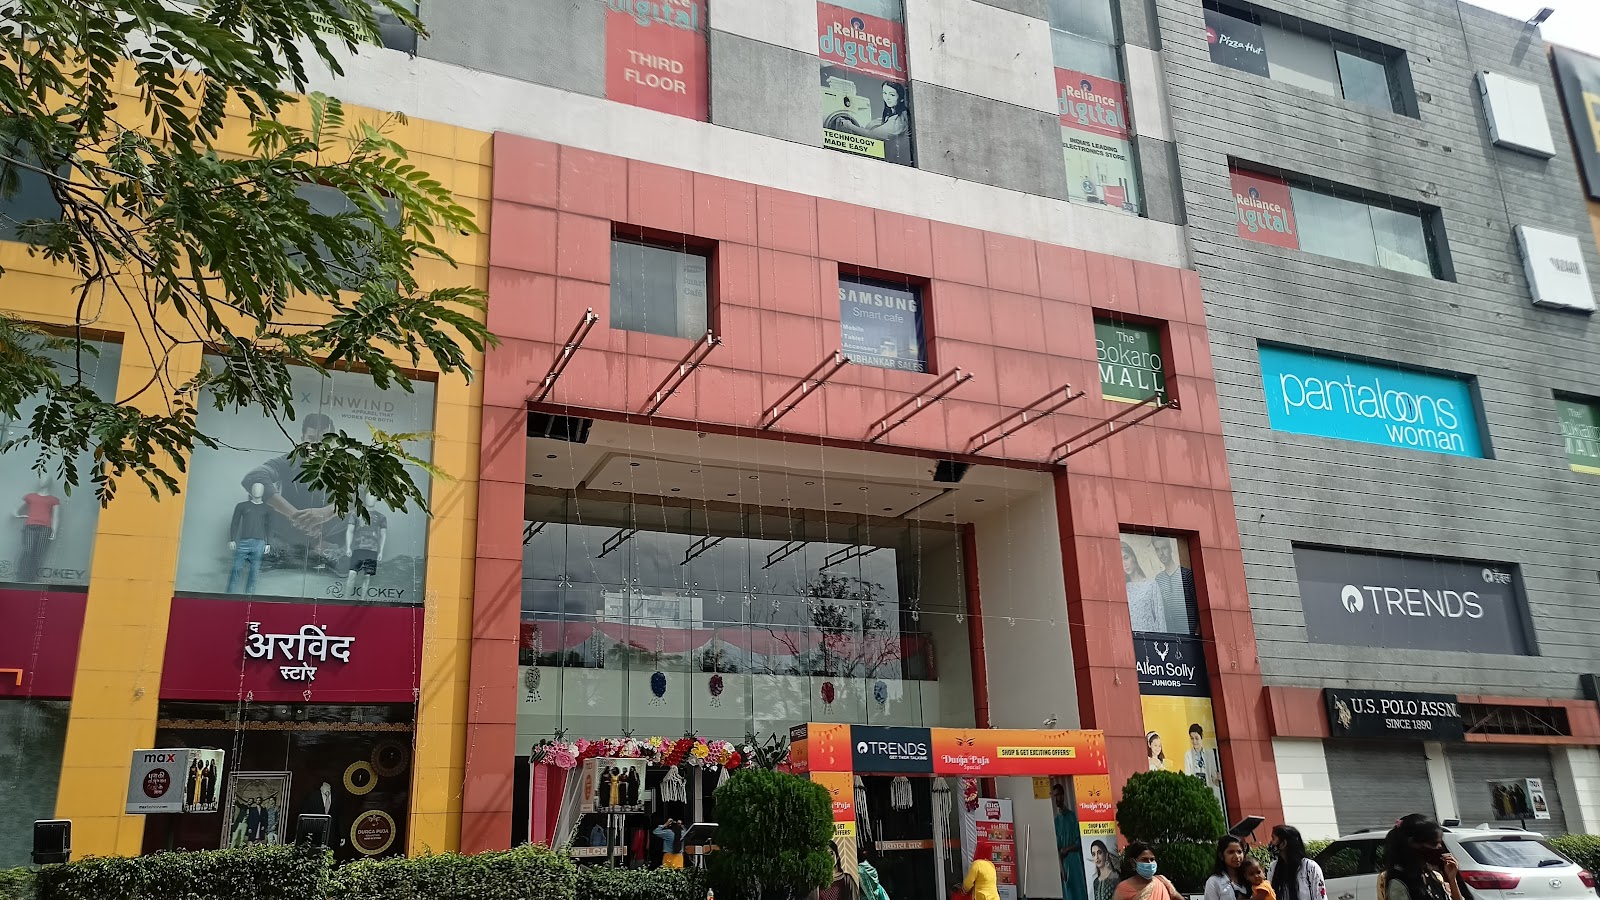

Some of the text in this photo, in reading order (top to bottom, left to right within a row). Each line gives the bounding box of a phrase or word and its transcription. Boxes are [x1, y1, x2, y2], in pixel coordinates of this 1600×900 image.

[833, 22, 891, 48] Reliance
[1219, 34, 1264, 55] Pizza Hut
[820, 26, 903, 72] digital
[627, 48, 684, 75] THIRD
[623, 67, 687, 95] FLOOR
[1066, 84, 1116, 107] Reliance
[1058, 88, 1127, 130] digital
[824, 130, 875, 148] TECHNOLOGY
[824, 137, 869, 153] MADE EASY
[1236, 193, 1282, 213] Reliance
[1234, 197, 1293, 235] igital
[838, 287, 917, 313] SAMSUNG
[852, 306, 904, 324] Smart cafe
[842, 323, 865, 333] Mobile
[843, 333, 865, 342] Tablet
[1115, 331, 1135, 344] The
[1095, 338, 1162, 372] Bokaro
[897, 361, 924, 373] SALES
[1098, 362, 1165, 393] MALL
[320, 394, 395, 412] UNWIND
[1279, 373, 1458, 430] pantaloons
[1385, 423, 1465, 452] woman
[1362, 585, 1484, 619] TRENDS
[244, 624, 356, 663] अरविंद
[279, 661, 318, 681] स्टोर
[1136, 661, 1194, 680] Allen Solly
[1151, 679, 1181, 687] JUNIORS
[1351, 698, 1461, 718] U.S. POLO ASSN.
[1385, 718, 1432, 731] SINCE 1890
[144, 753, 176, 763] max
[867, 742, 927, 756] TRENDS
[941, 755, 990, 767] Durga Puja
